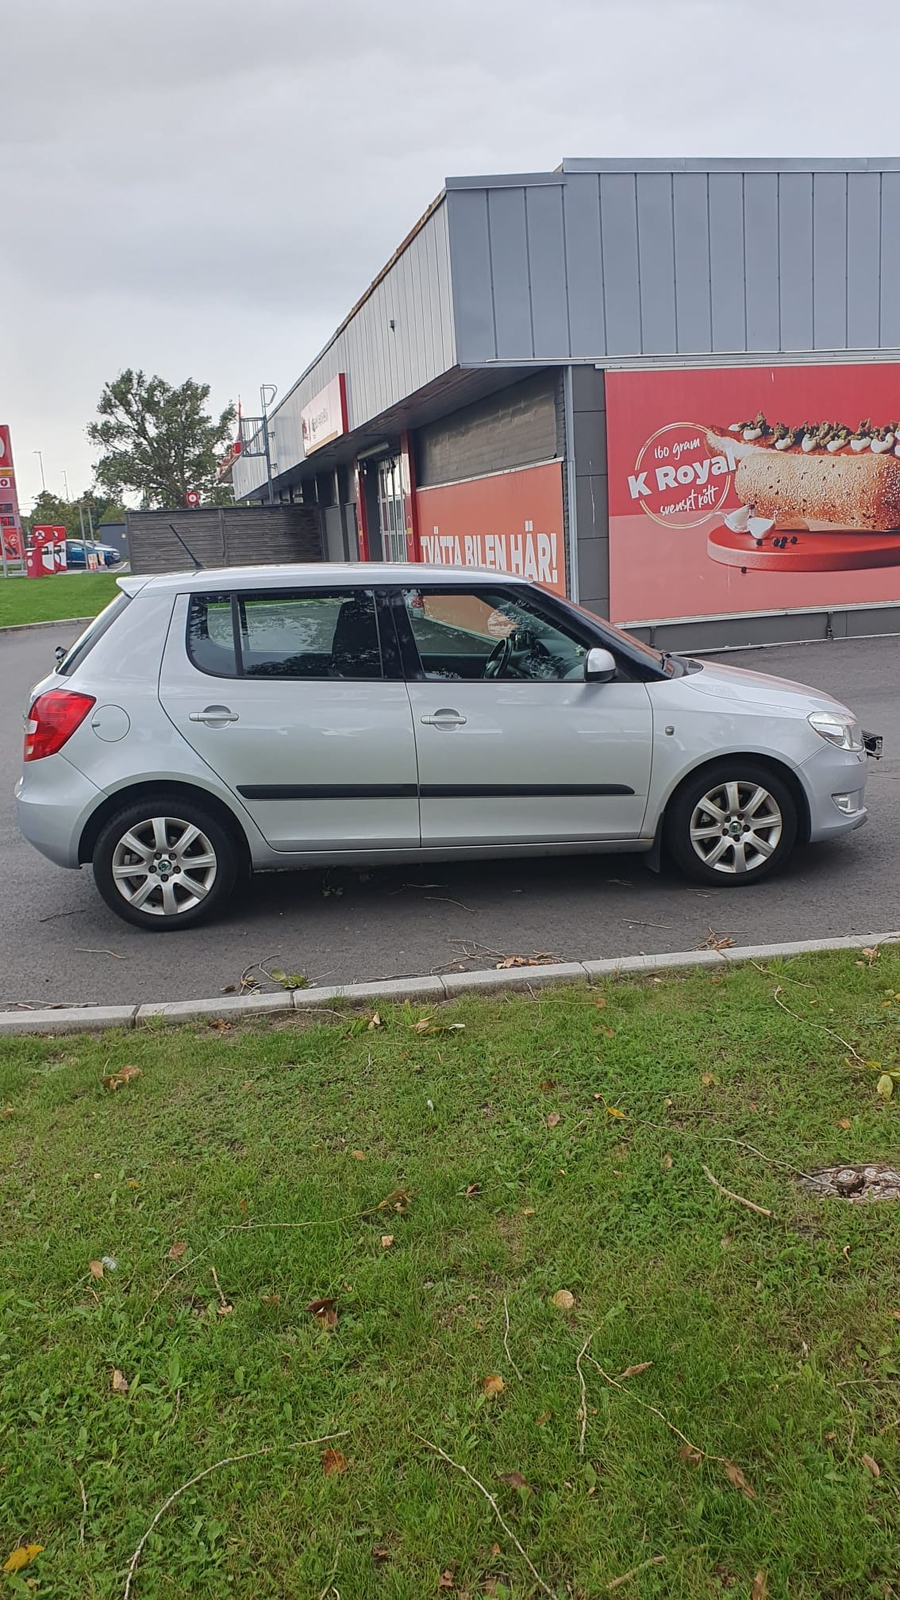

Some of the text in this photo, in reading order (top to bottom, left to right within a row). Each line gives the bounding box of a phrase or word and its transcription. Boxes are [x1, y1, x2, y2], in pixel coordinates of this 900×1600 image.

[654, 438, 700, 461] 160 gram
[627, 447, 737, 499] K Royal
[660, 484, 719, 516] svenskt kött
[464, 534, 507, 573] BILEN
[510, 520, 558, 583] HÄR!
